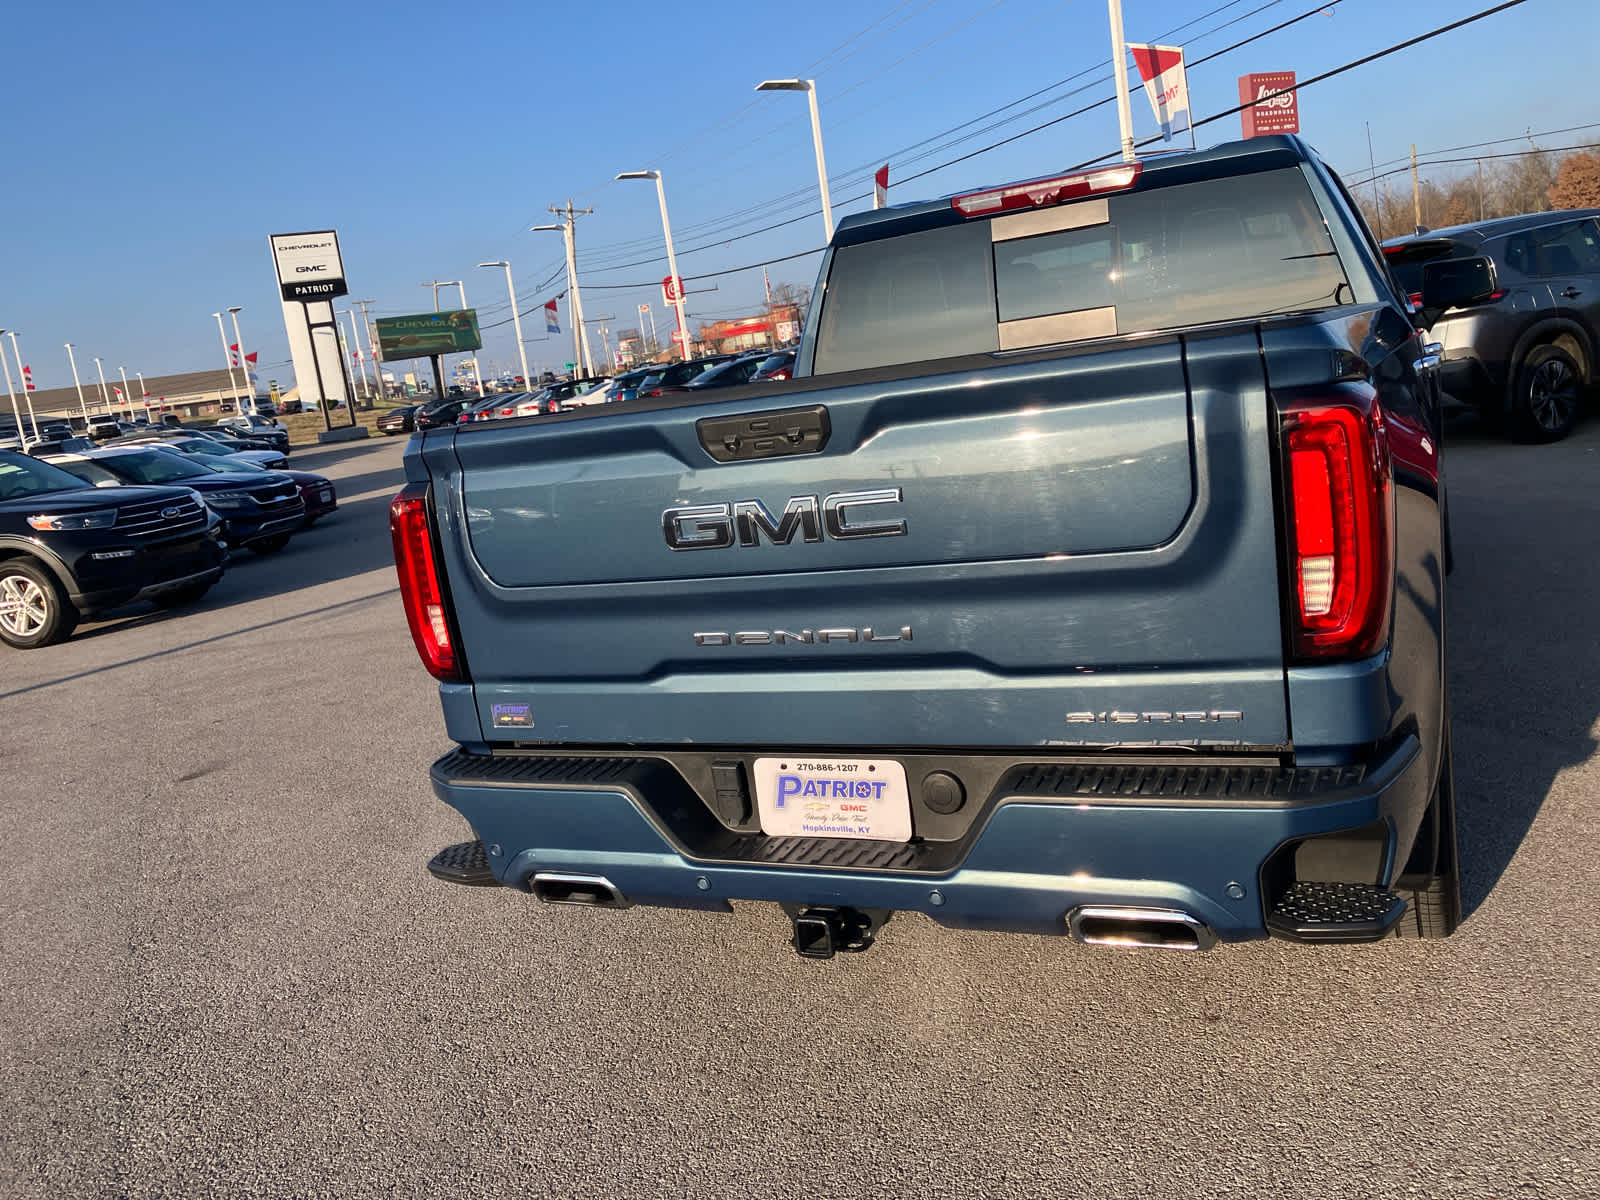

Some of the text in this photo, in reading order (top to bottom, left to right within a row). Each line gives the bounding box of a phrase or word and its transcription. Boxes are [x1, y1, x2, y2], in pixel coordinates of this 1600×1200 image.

[279, 243, 331, 251] CHEVROLET
[295, 265, 327, 273] GMC
[295, 284, 334, 295] PATRIOT
[662, 487, 908, 551] GMC
[694, 626, 912, 646] DENALI
[1066, 711, 1243, 723] SIERRA
[797, 763, 859, 772] 270-886-1207
[775, 774, 887, 808] PATRIOT
[840, 804, 868, 812] GMC
[802, 824, 871, 834] Hopkinsville, KY
